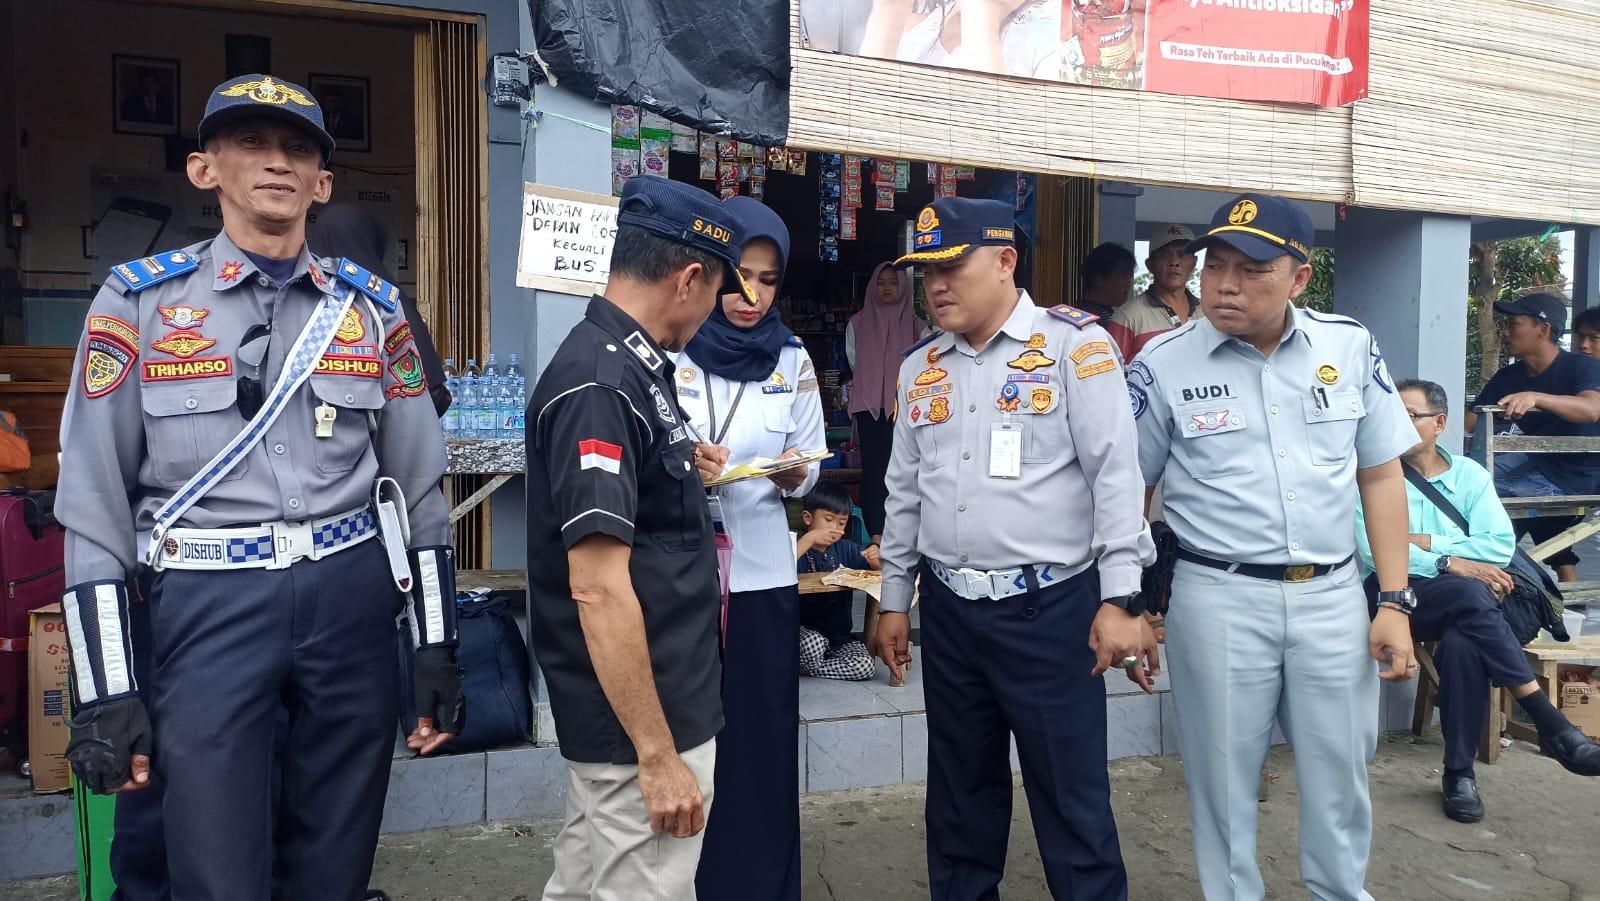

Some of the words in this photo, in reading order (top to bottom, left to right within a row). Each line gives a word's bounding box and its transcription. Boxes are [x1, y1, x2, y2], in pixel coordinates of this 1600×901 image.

[1170, 45, 1194, 57] Rasa
[1197, 48, 1215, 60] Teh
[1217, 49, 1256, 63] Terbaik
[1258, 54, 1280, 64] Ada
[1282, 54, 1293, 65] di
[693, 219, 731, 242] SADU
[553, 239, 605, 255] KECUALI
[554, 256, 596, 273] BUS
[147, 361, 227, 377] TRIHARSO
[316, 360, 379, 374] DISHUB
[1182, 384, 1230, 401] BUDI
[183, 542, 222, 560] DISHUB
